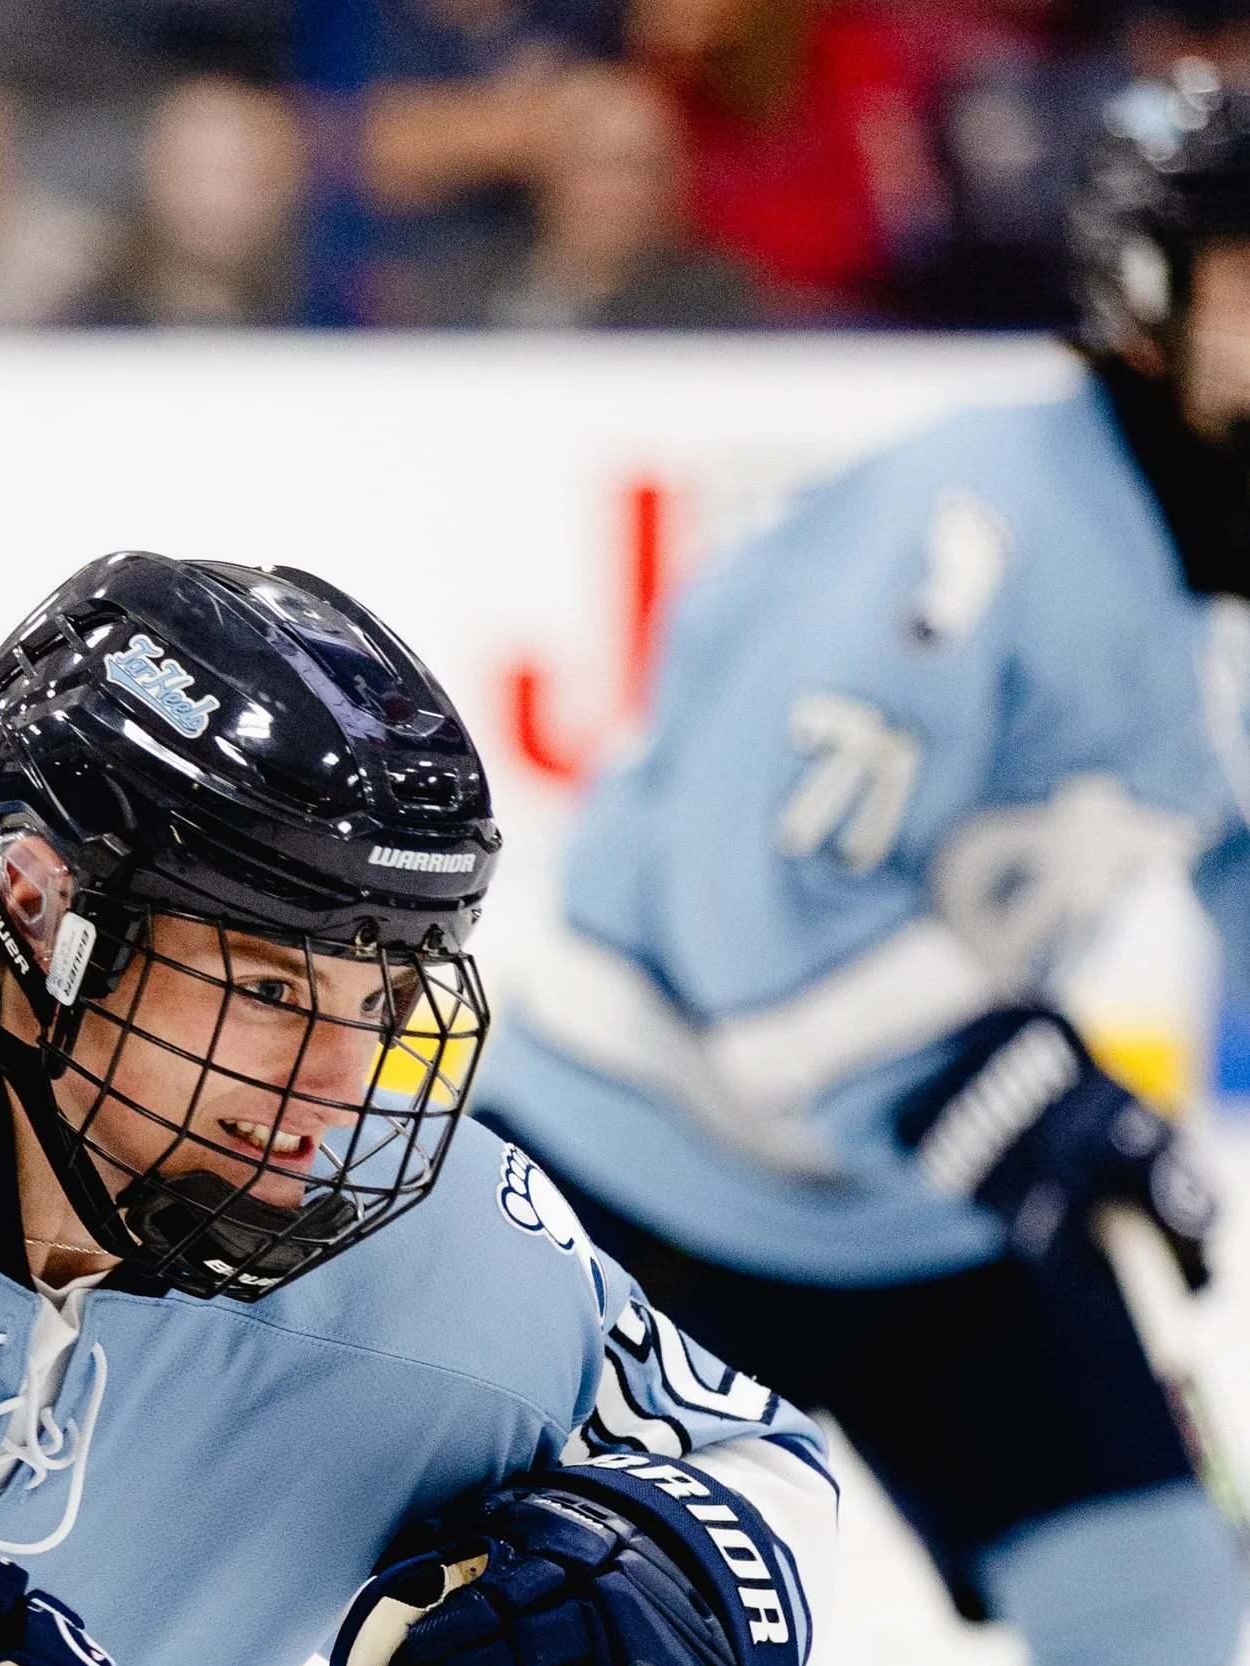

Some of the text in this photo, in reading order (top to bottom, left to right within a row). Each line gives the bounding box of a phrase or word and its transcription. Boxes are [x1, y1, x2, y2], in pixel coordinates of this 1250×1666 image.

[113, 634, 220, 733] Tar Heels
[368, 845, 476, 873] WARRIOR
[588, 1453, 790, 1646] RRIOR
